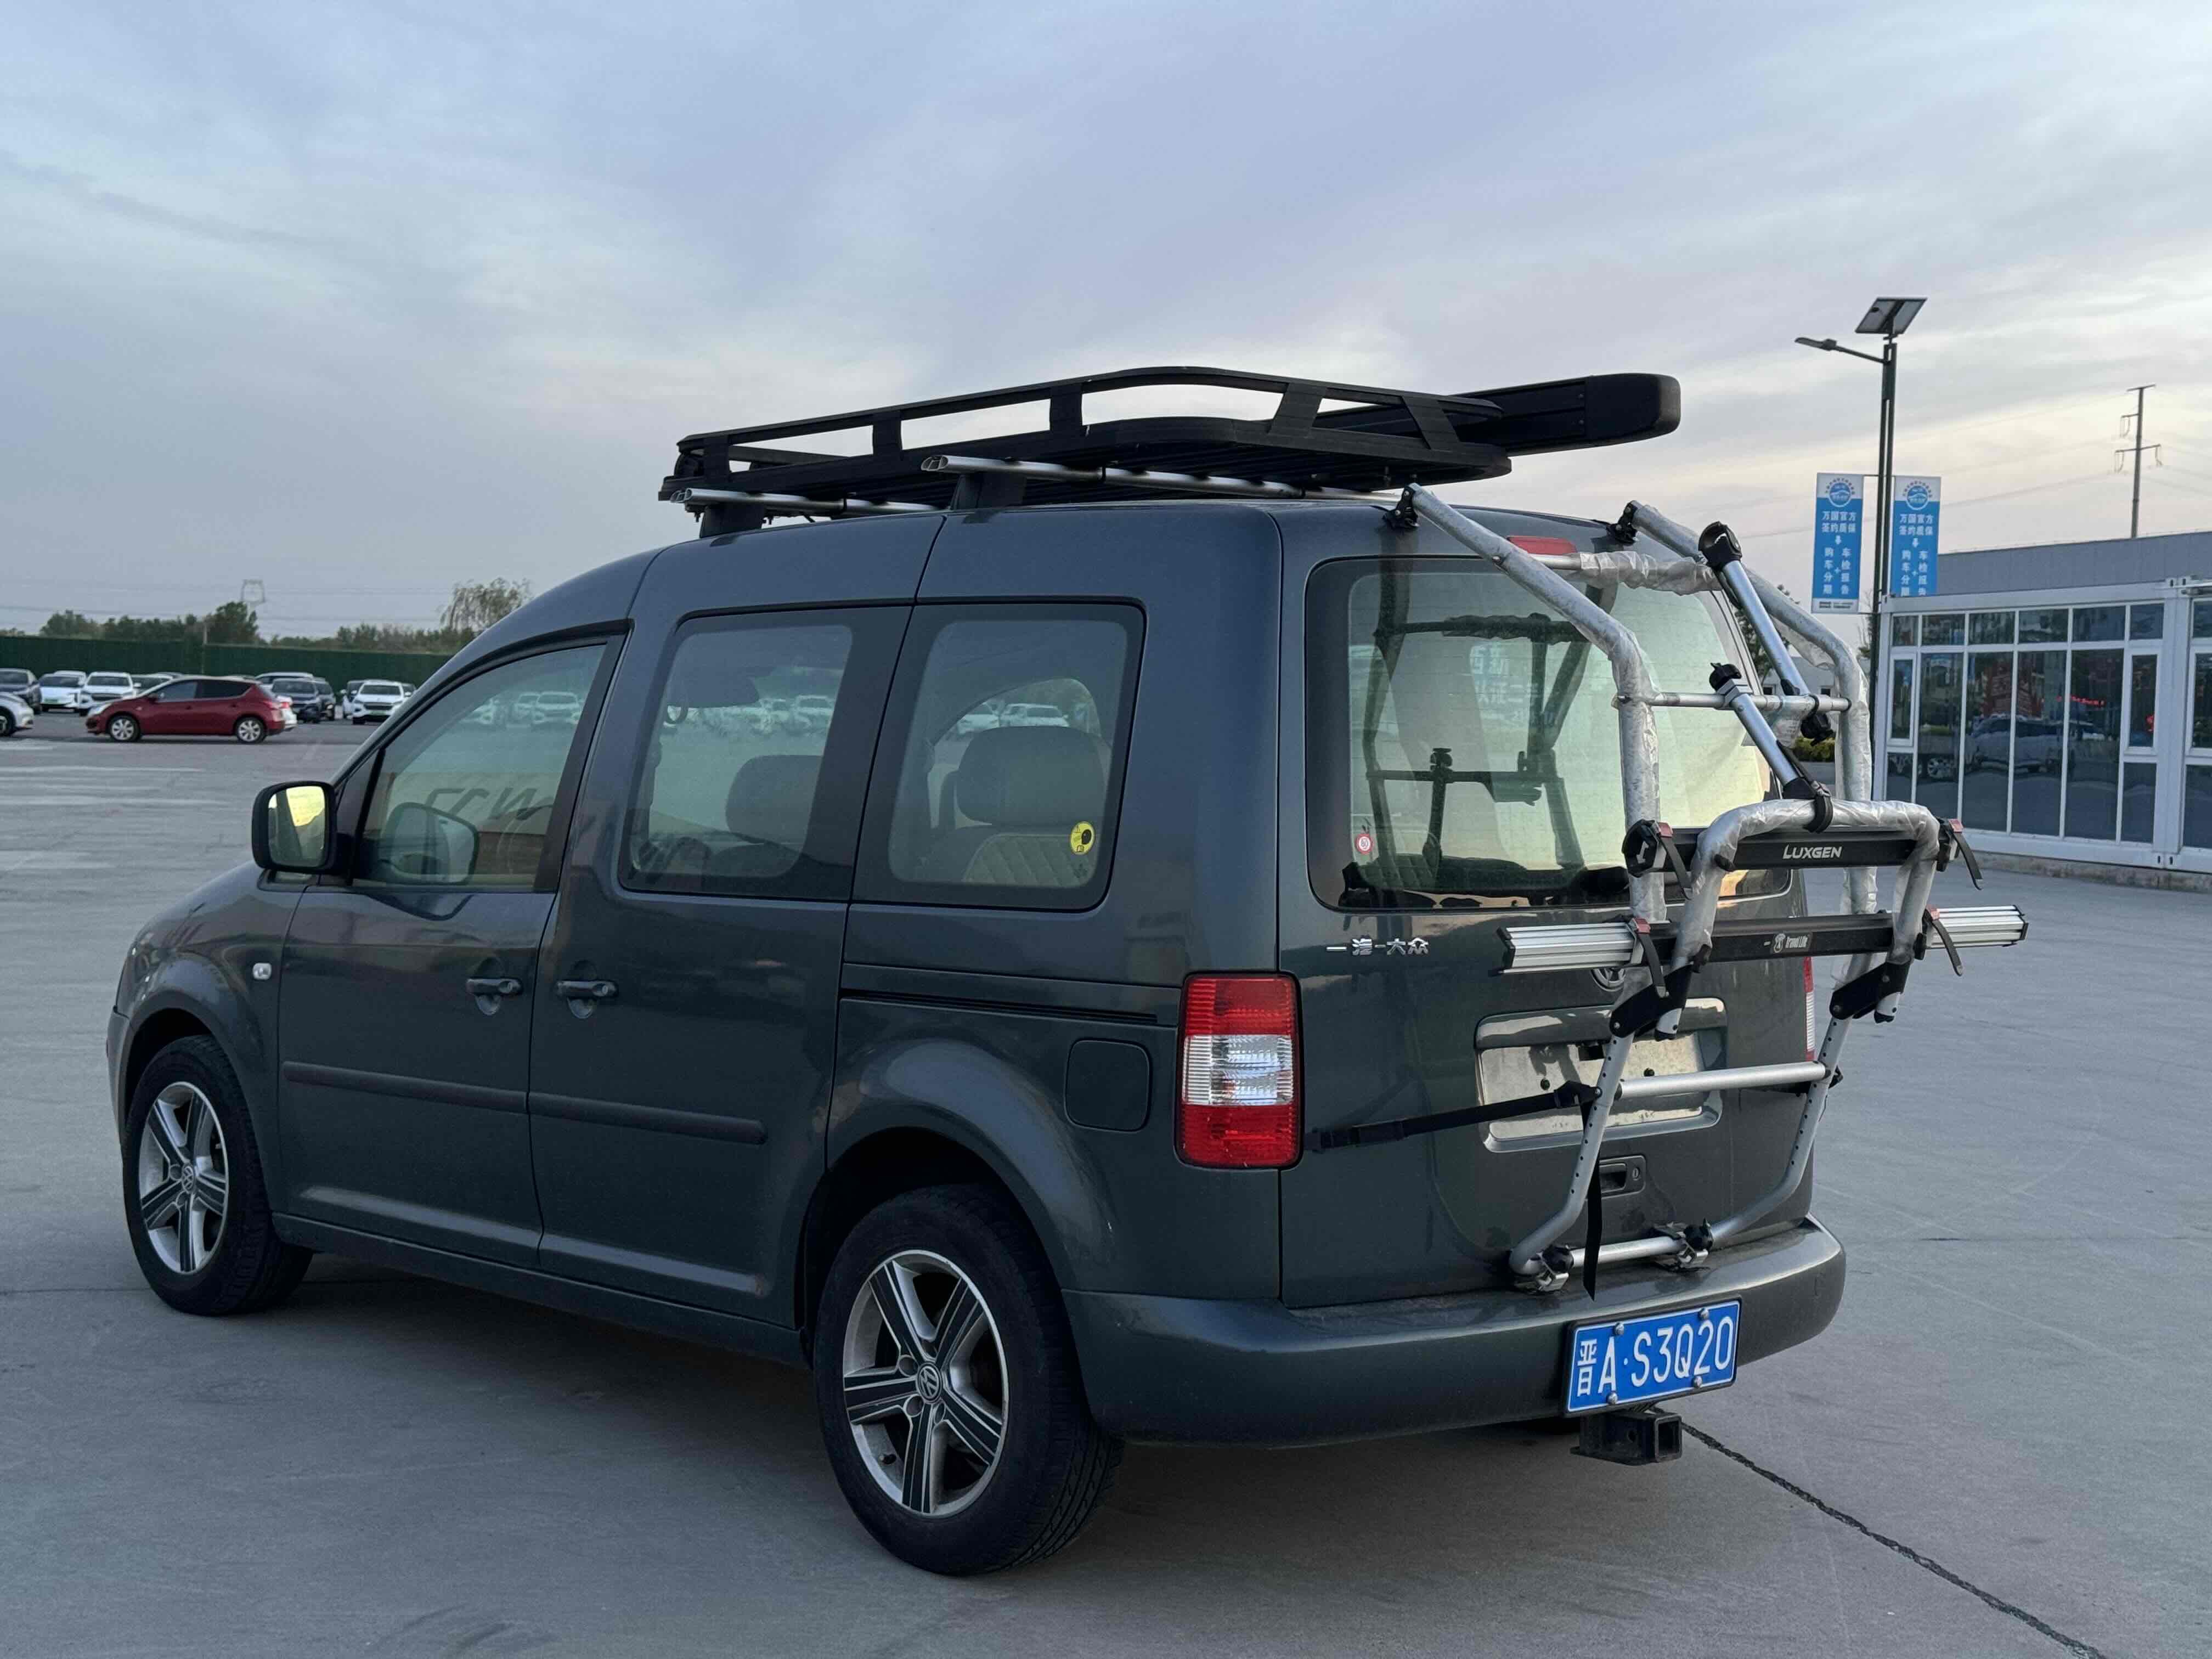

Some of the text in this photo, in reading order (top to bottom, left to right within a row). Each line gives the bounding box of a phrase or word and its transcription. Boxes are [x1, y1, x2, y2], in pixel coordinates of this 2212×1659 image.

[1821, 511, 1857, 522] 万国官方
[1821, 522, 1857, 534] 签约质保
[1783, 844, 1843, 859] LUXGEN
